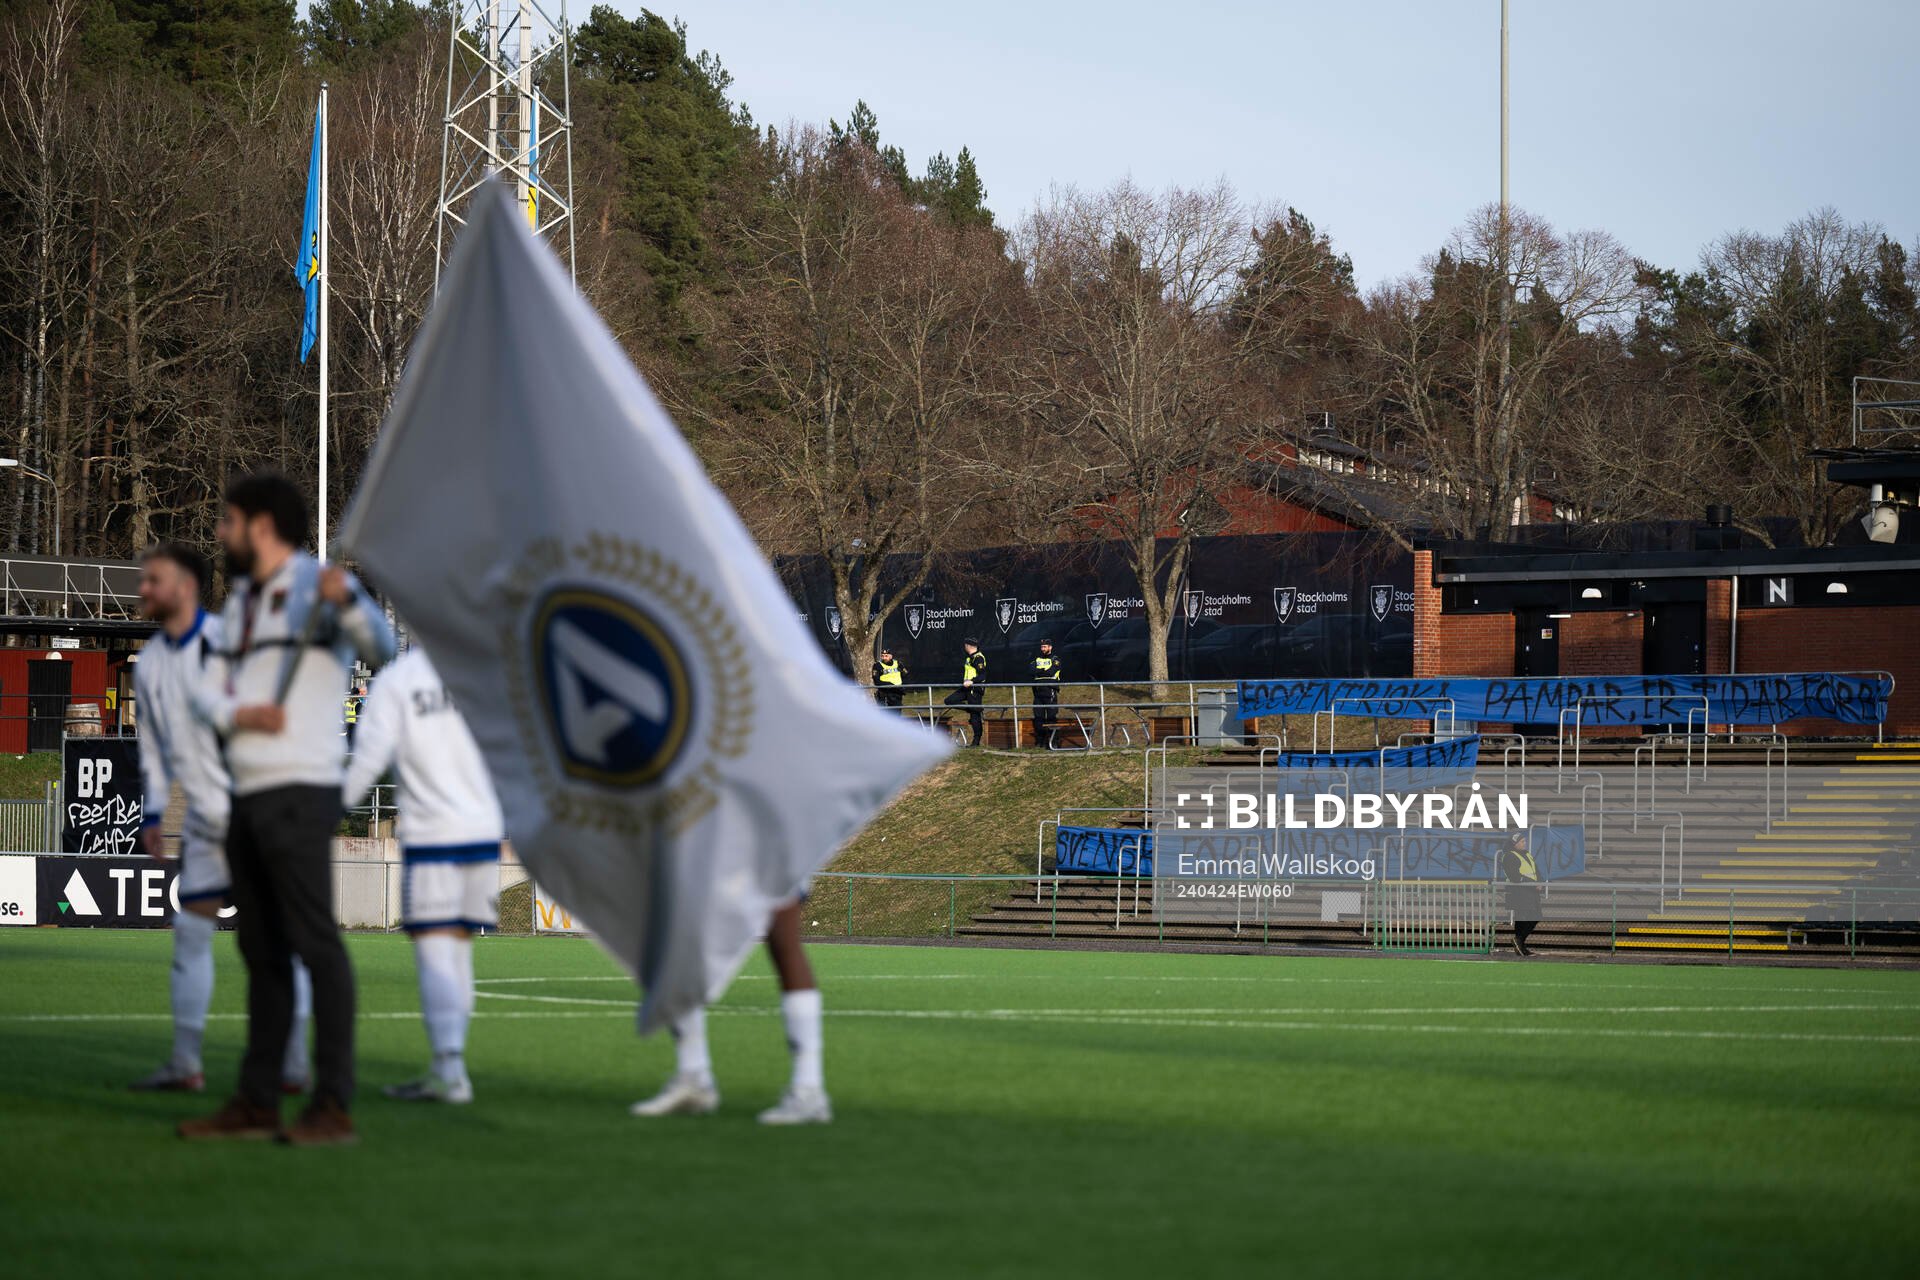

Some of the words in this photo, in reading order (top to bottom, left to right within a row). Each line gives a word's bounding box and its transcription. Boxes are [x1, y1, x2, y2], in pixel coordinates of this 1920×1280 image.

[1769, 578, 1787, 603] N
[1108, 597, 1144, 609] Stockho
[1205, 594, 1251, 606] Stockholms
[1297, 592, 1348, 603] Stockholms
[926, 607, 974, 619] Stockholms
[1017, 601, 1063, 613] Stockholms
[1205, 606, 1222, 616] stad
[1297, 602, 1317, 613] stad
[1018, 612, 1037, 623] stad
[1108, 608, 1128, 619] stad
[927, 618, 945, 629] stad
[78, 758, 113, 798] BP
[68, 794, 144, 828] FOOTBAL
[80, 827, 139, 854] CAMPS
